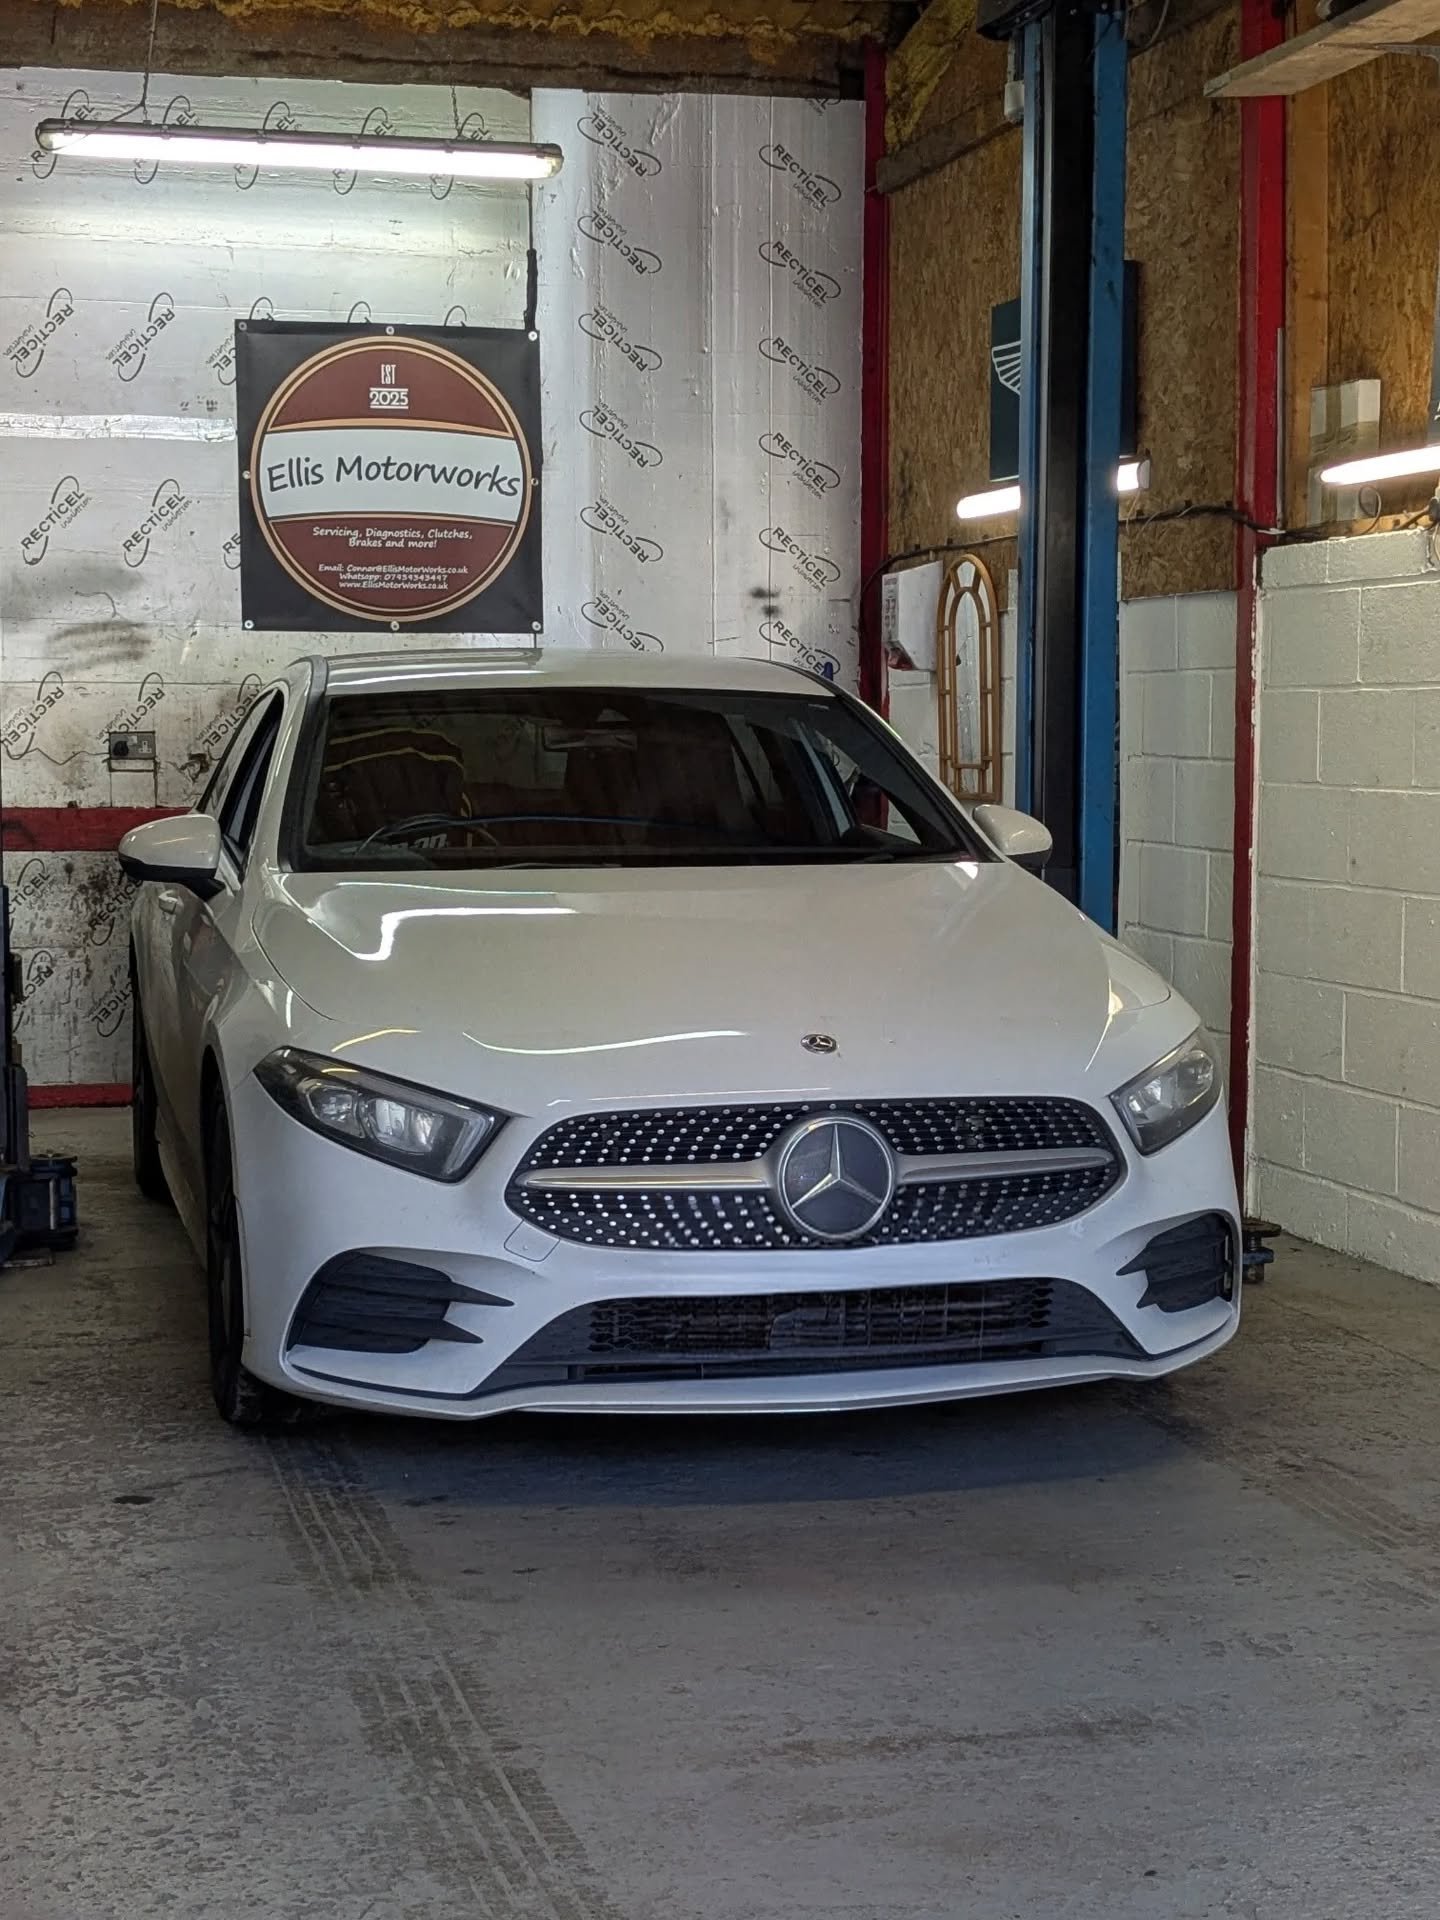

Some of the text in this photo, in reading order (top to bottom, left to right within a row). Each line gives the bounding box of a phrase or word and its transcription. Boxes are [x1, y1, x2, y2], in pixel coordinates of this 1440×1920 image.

[591, 112, 647, 176] RECTICEL
[772, 143, 829, 208] RECTICEL
[591, 210, 647, 274] RECTICEL
[772, 240, 829, 304] RECTICEL
[11, 304, 74, 363] RECTICEL
[112, 308, 175, 368] RECTICEL
[592, 308, 648, 372] RECTICEL
[369, 391, 409, 405] 2025
[381, 364, 396, 385] EST
[772, 337, 829, 400] RECTICEL
[592, 405, 649, 468] RECTICEL
[772, 432, 828, 493] RECTICEL
[267, 455, 521, 496] Ellis Motorworks
[21, 490, 85, 550] RECTICEL
[122, 492, 185, 551] RECTICEL
[312, 526, 473, 540] Servicing, Diagnostics, Clutches,
[349, 537, 437, 548] Brakes and more!
[593, 501, 650, 563] RECTICEL
[318, 563, 344, 572] Email:
[772, 527, 828, 587] RECTICEL
